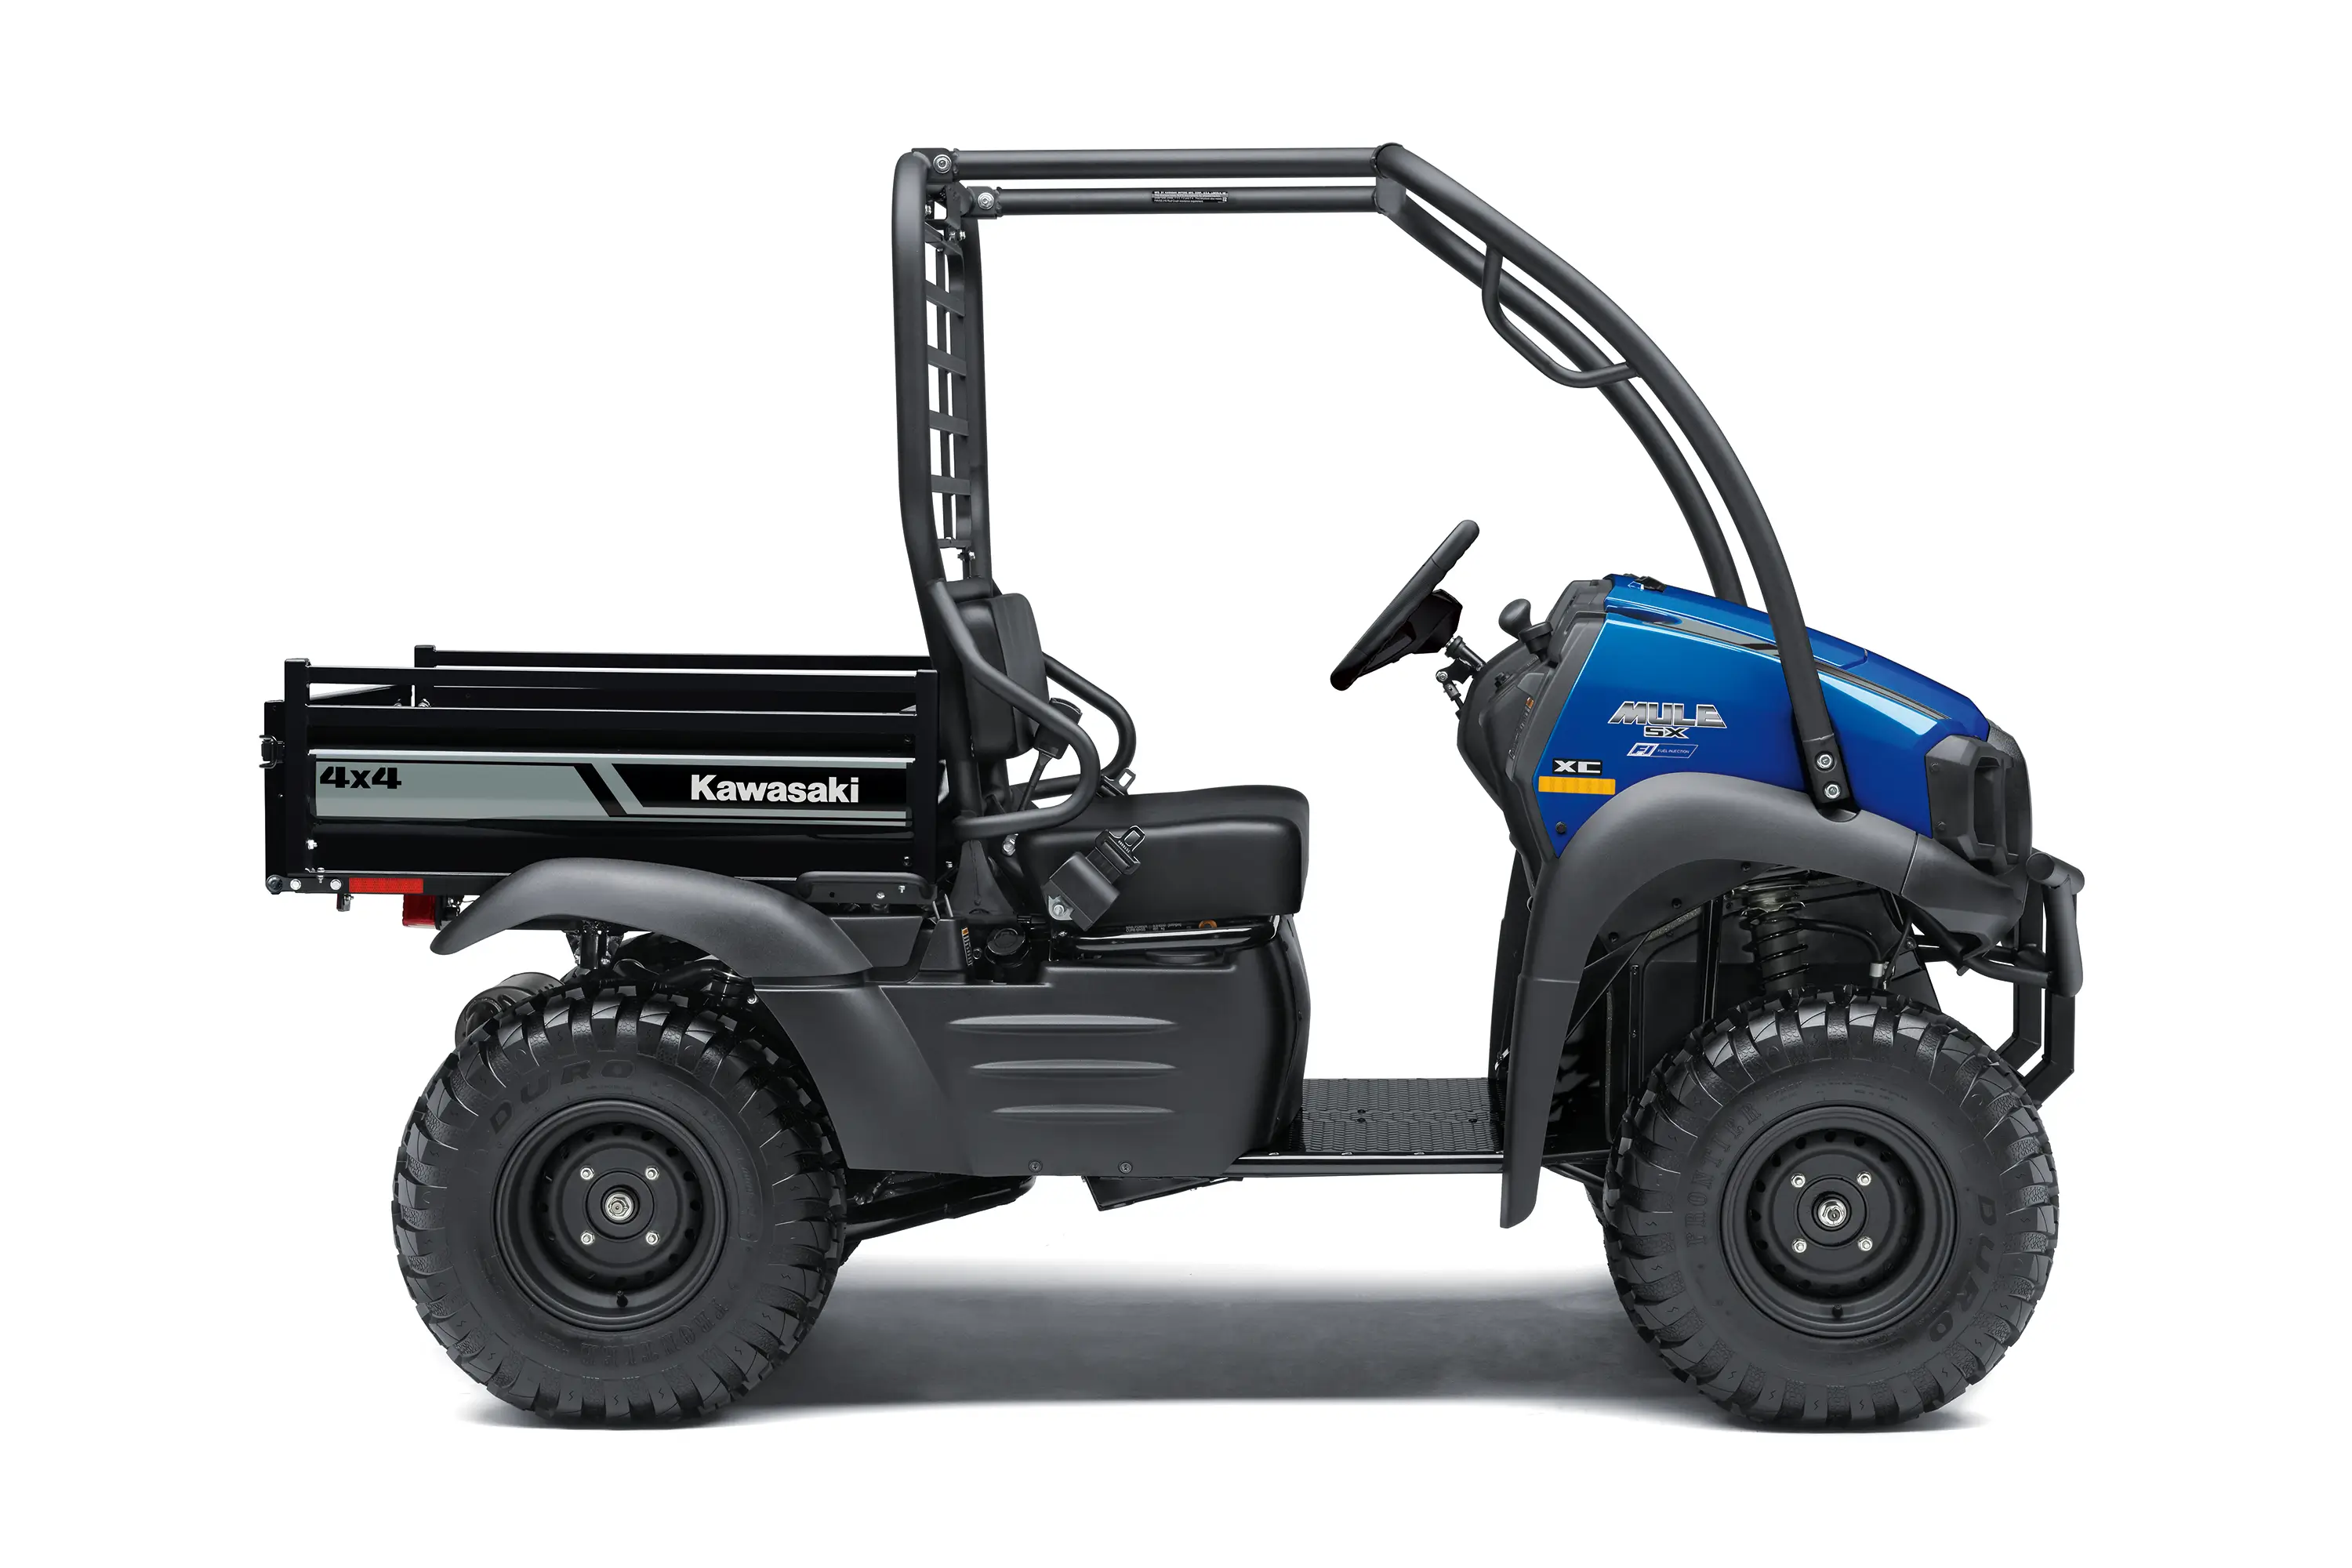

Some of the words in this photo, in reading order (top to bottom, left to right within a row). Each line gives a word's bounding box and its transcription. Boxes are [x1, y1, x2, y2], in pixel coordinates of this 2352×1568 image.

[1607, 700, 1727, 728] MULE
[1643, 725, 1690, 739] SX
[1628, 742, 1659, 757] FI
[320, 766, 402, 789] 4x4
[1554, 760, 1601, 774] XC
[691, 774, 859, 804] Kawasaki
[489, 1058, 636, 1134] DURO
[1684, 1102, 1762, 1248] FRONTIER
[1928, 1193, 1998, 1343] DURO
